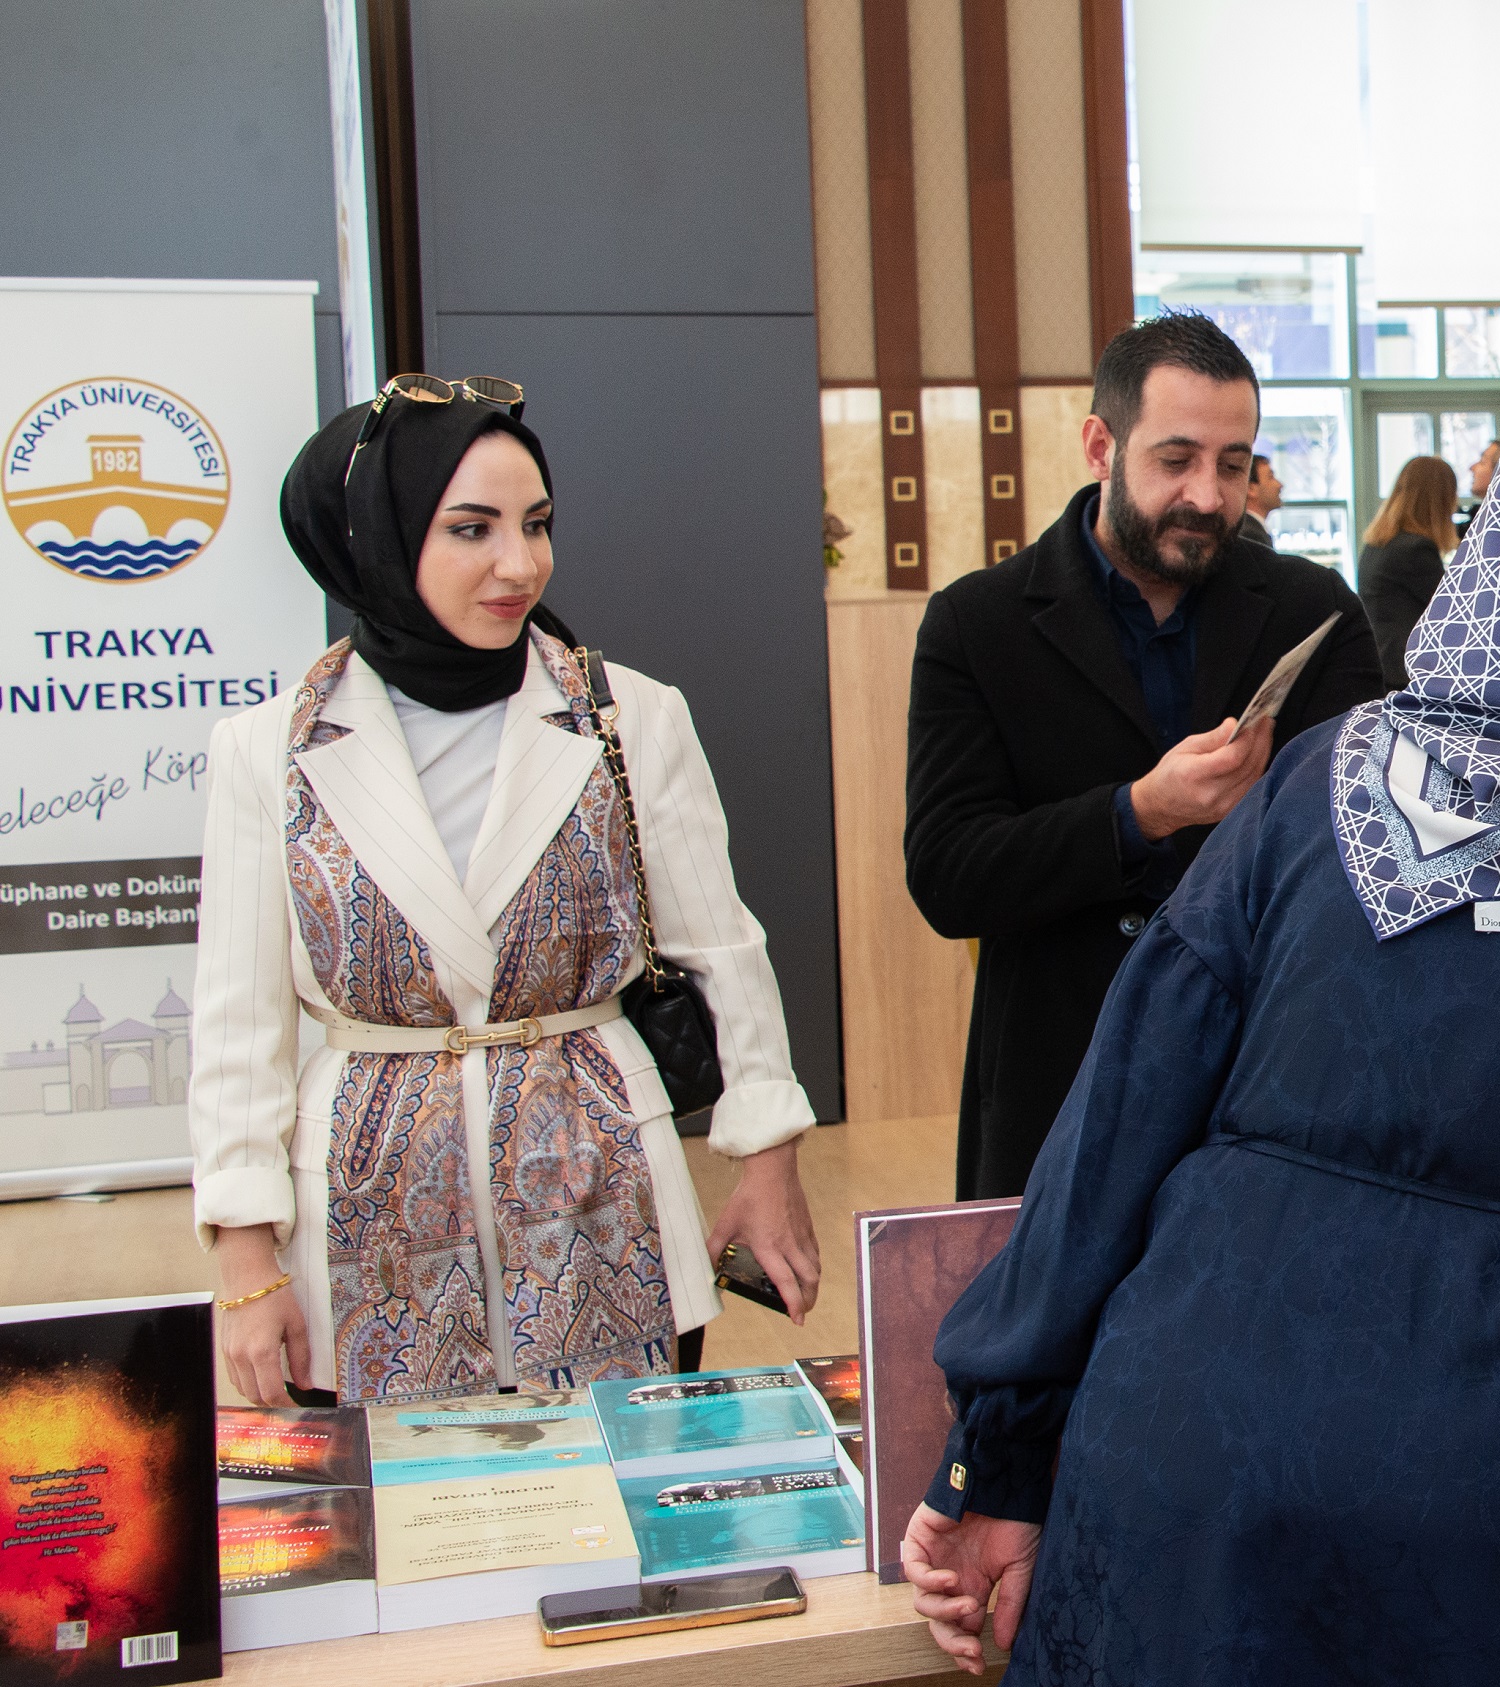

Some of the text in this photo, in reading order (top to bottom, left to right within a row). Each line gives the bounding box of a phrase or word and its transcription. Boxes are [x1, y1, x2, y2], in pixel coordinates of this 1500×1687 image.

[11, 384, 226, 478] TRAKYA ÜNİVERSİTESİ
[93, 450, 139, 472] 1982
[35, 628, 215, 659] TRAKYA
[144, 746, 208, 791] Köp
[93, 882, 121, 898] ve
[47, 909, 110, 931] Daire
[432, 1485, 554, 1500] BİLDİRİ KİTABI
[775, 1481, 836, 1490] MEHMET
[241, 1524, 329, 1538] BİLDİRİLER
